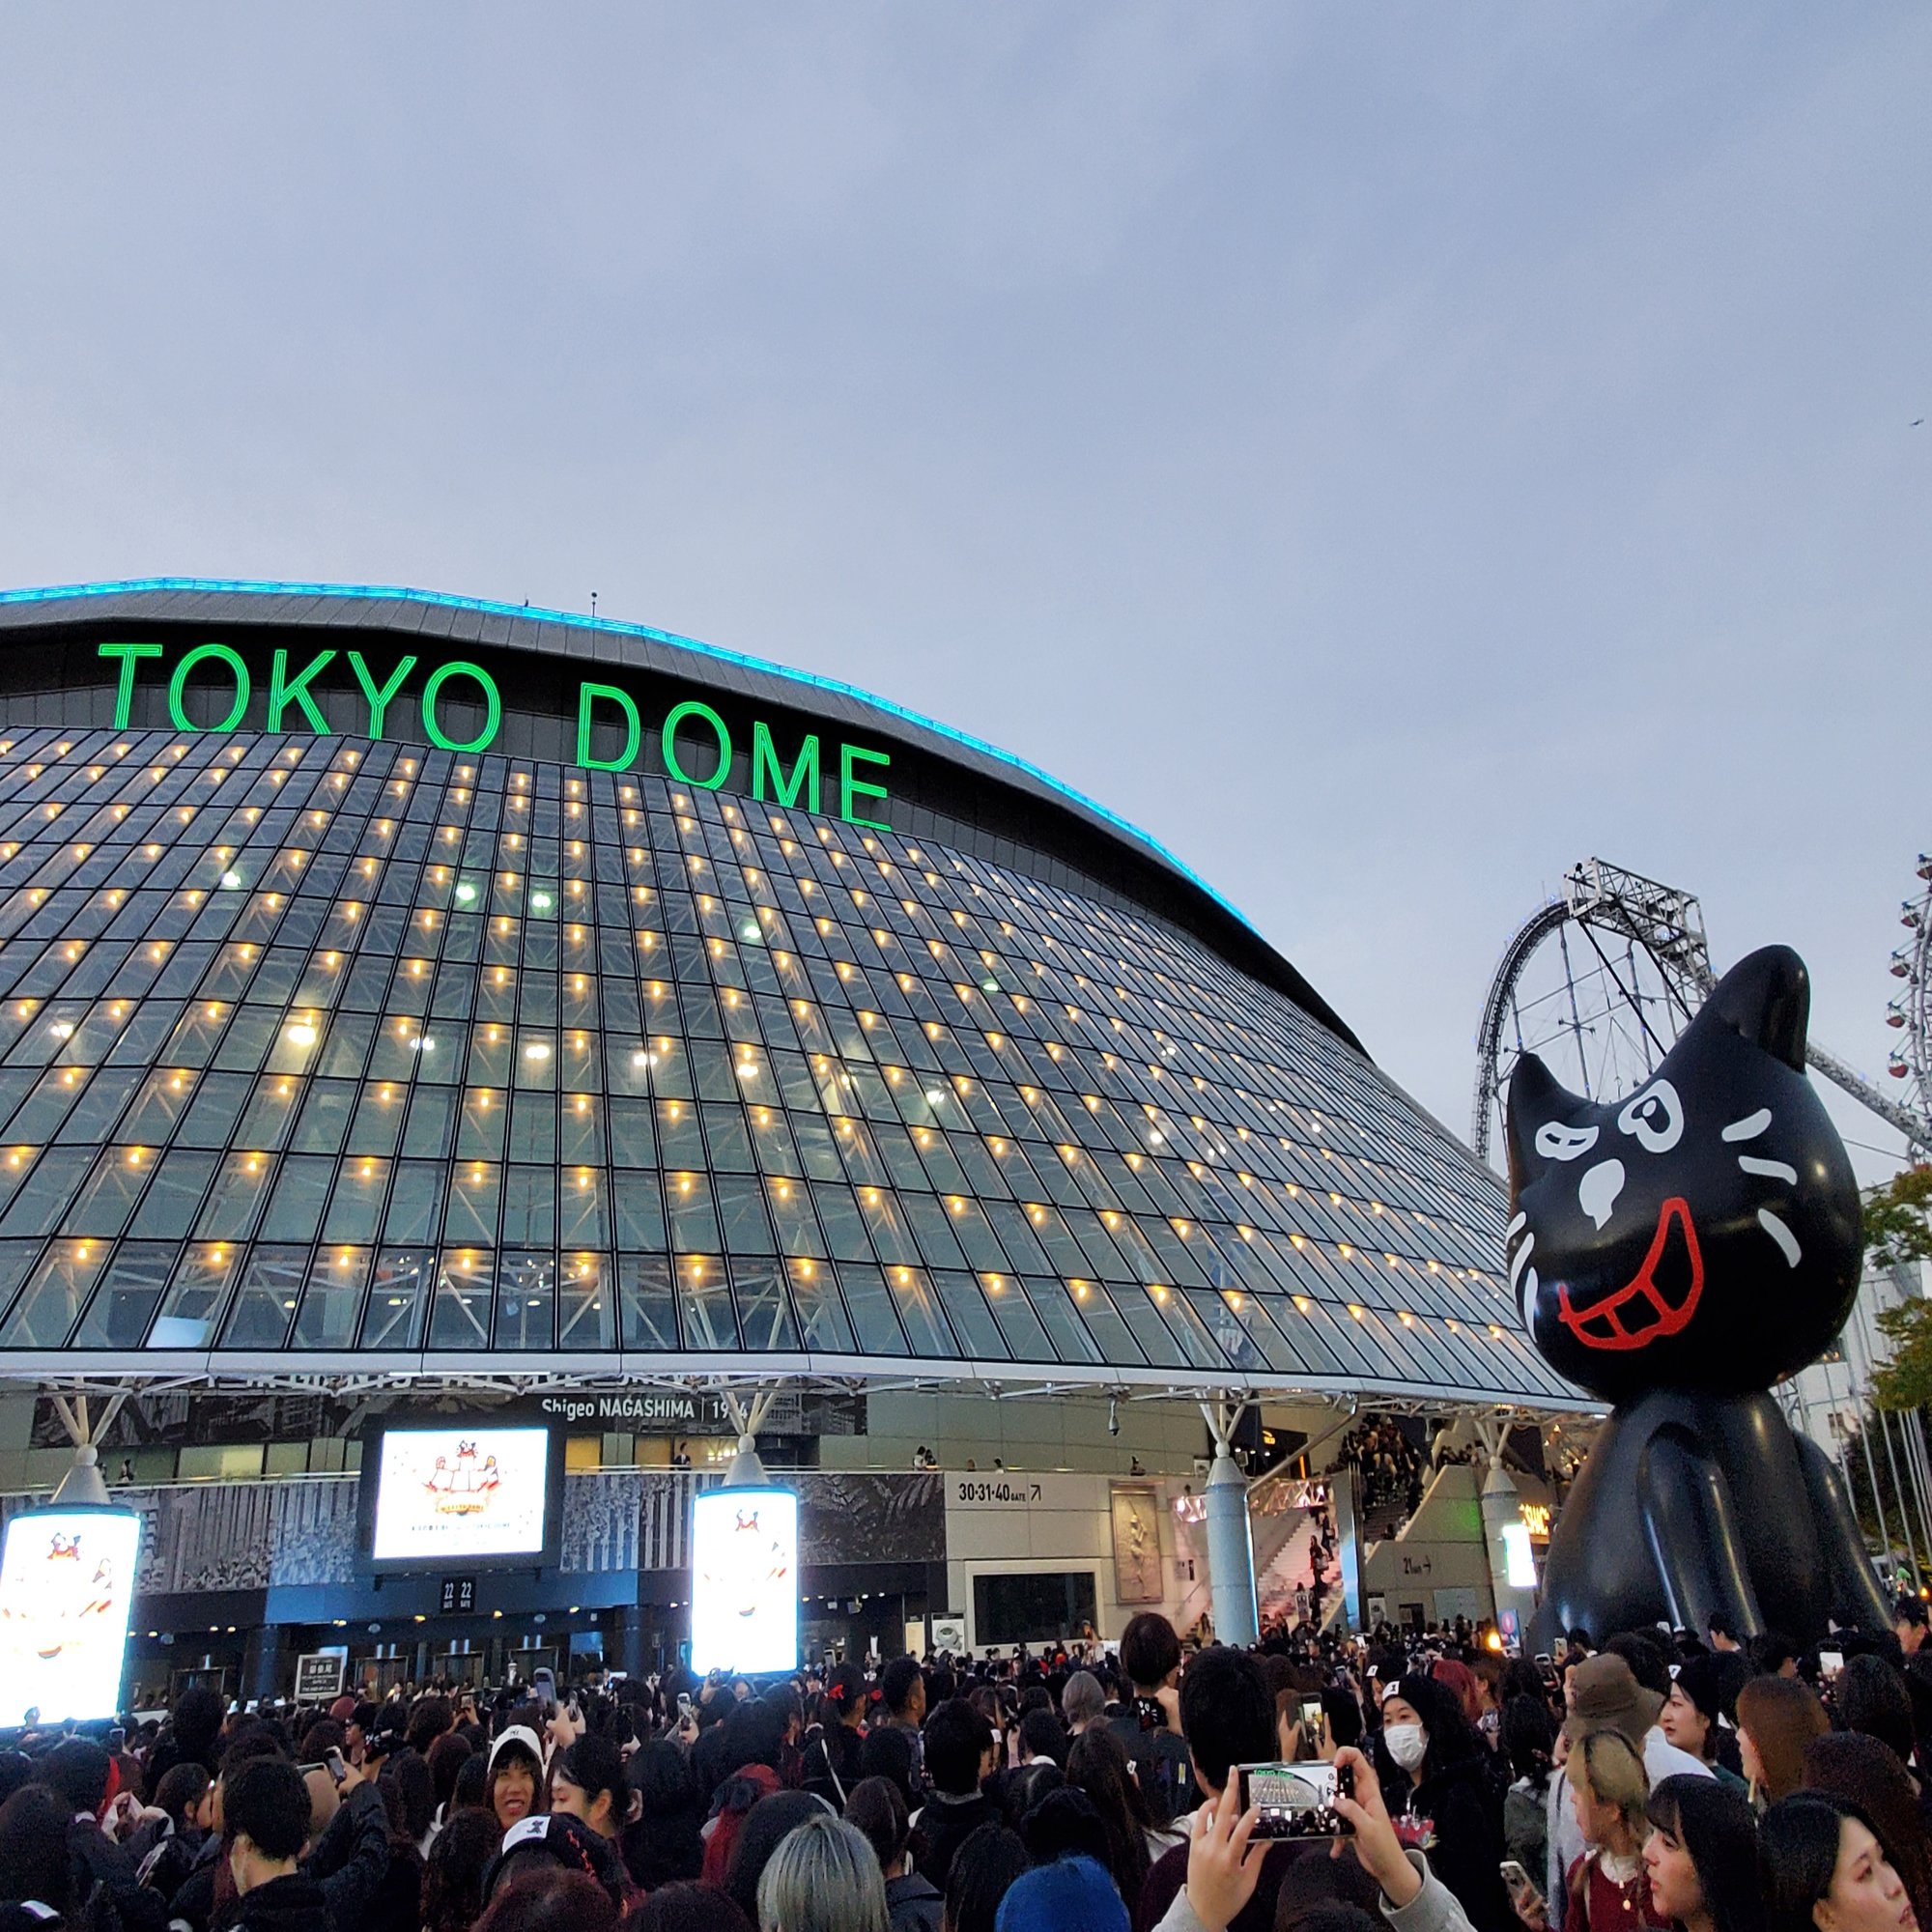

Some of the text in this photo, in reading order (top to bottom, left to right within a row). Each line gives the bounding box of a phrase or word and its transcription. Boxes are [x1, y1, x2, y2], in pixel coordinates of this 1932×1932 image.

[98, 643, 892, 832] TOKYO DOME
[541, 1398, 748, 1422] Shigeo NAGASHIMA 194
[444, 1581, 472, 1600] 22 22
